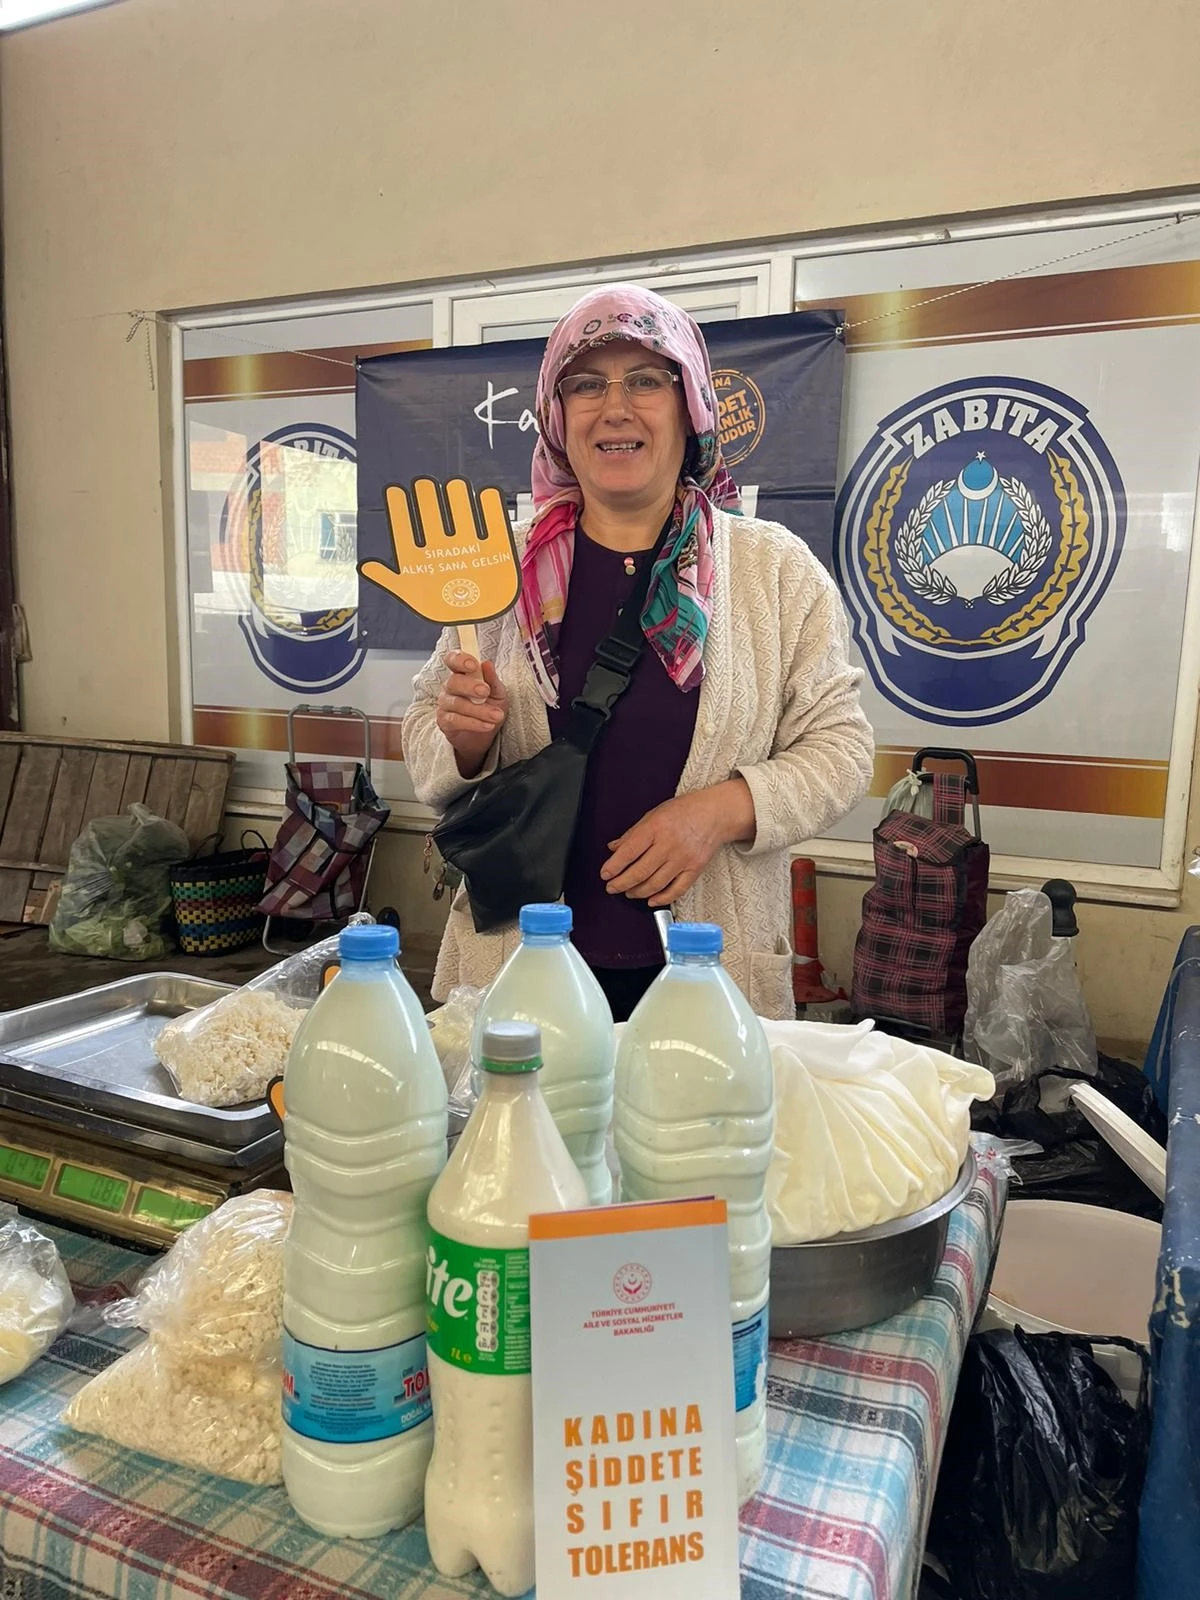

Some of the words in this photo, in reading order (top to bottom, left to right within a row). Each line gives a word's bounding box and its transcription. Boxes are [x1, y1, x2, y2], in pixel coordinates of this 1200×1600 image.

[901, 398, 1059, 459] ZABITA
[402, 563, 434, 575] ALKIŞ
[440, 560, 468, 572] SANA
[472, 552, 511, 568] GELSİN
[425, 543, 481, 559] SIRADAKİ
[583, 1320, 599, 1329] AİLE
[601, 1319, 610, 1327] VE
[612, 1317, 640, 1326] SOSYAL
[642, 1312, 683, 1323] HİZMETLER
[591, 1308, 622, 1318] TÜRKİYE
[624, 1302, 675, 1315] CUMHURİYETİ
[613, 1324, 654, 1336] BAKANLIĞI
[564, 1404, 702, 1447] KADINA
[566, 1446, 702, 1496] ŞİDDETE
[566, 1489, 703, 1534] SIFIR
[567, 1531, 704, 1577] TOLERANS
